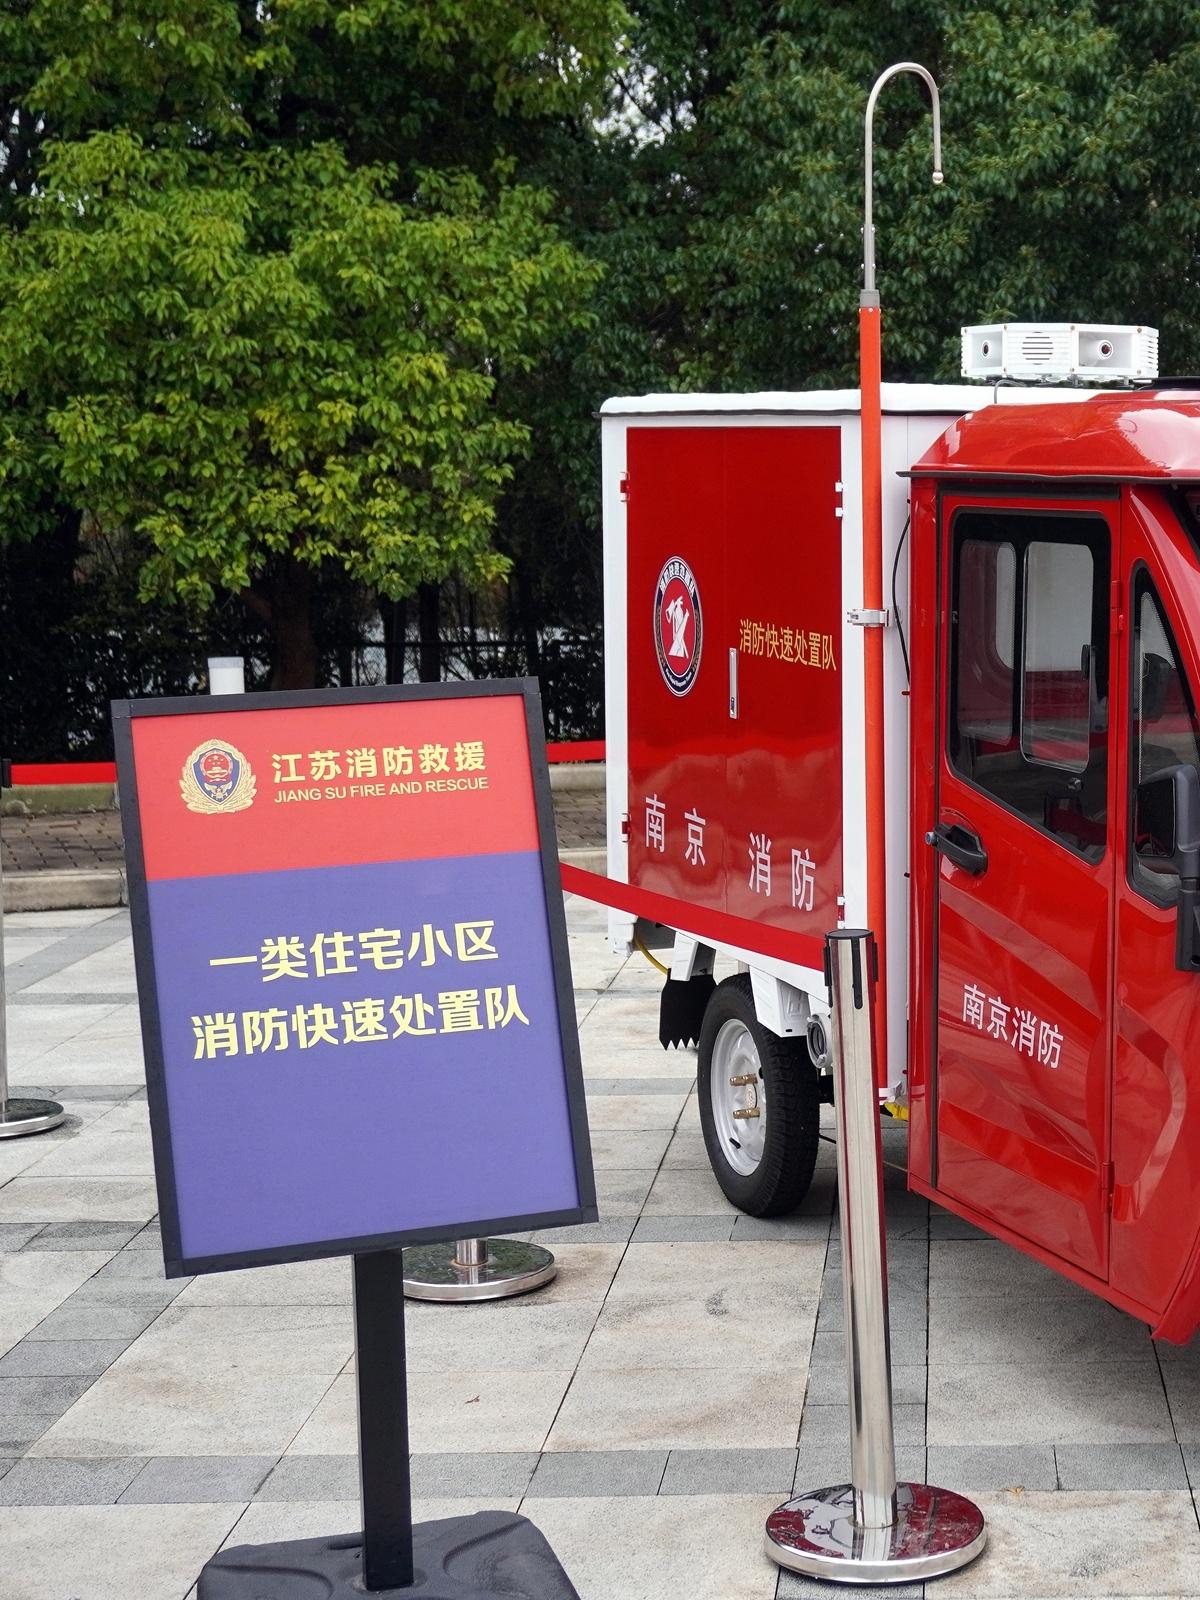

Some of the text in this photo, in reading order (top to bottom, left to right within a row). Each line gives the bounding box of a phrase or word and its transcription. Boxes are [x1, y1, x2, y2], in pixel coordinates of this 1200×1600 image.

[739, 619, 837, 671] 消防快速处置队
[271, 741, 486, 784] 江苏消防救援
[274, 777, 489, 803] JIANG SU FIRE AND RESCUE
[209, 920, 499, 983] 一类住宅小区
[191, 984, 529, 1059] 消防快速处置队
[963, 984, 1064, 1069] 南京消防
